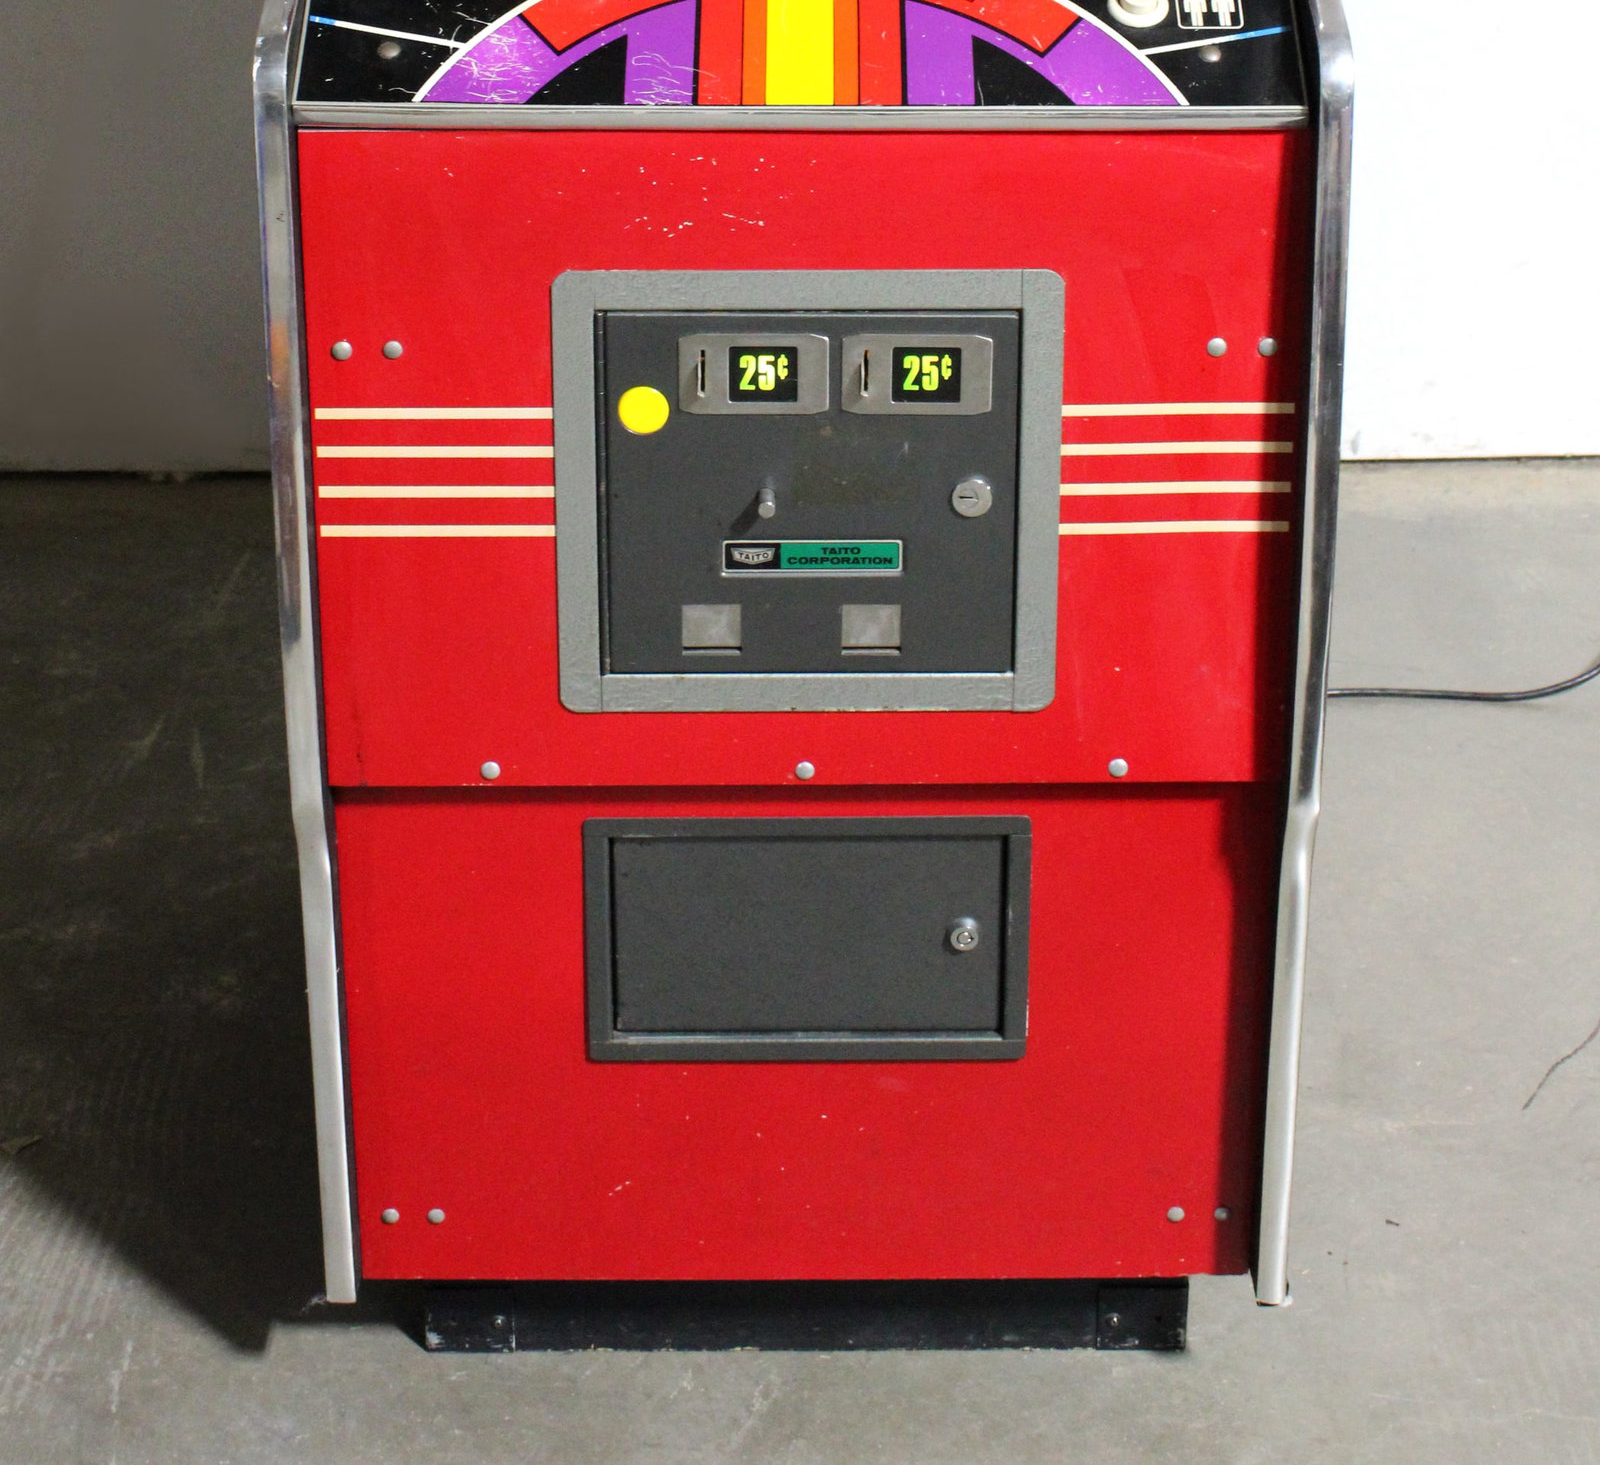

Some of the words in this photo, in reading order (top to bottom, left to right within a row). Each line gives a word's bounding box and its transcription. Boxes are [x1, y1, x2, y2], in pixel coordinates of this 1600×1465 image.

[739, 354, 788, 391] 25¢
[903, 354, 952, 391] 25¢
[821, 546, 861, 555] TAITO
[738, 551, 770, 562] TAITO
[787, 556, 893, 565] CORPORATION
